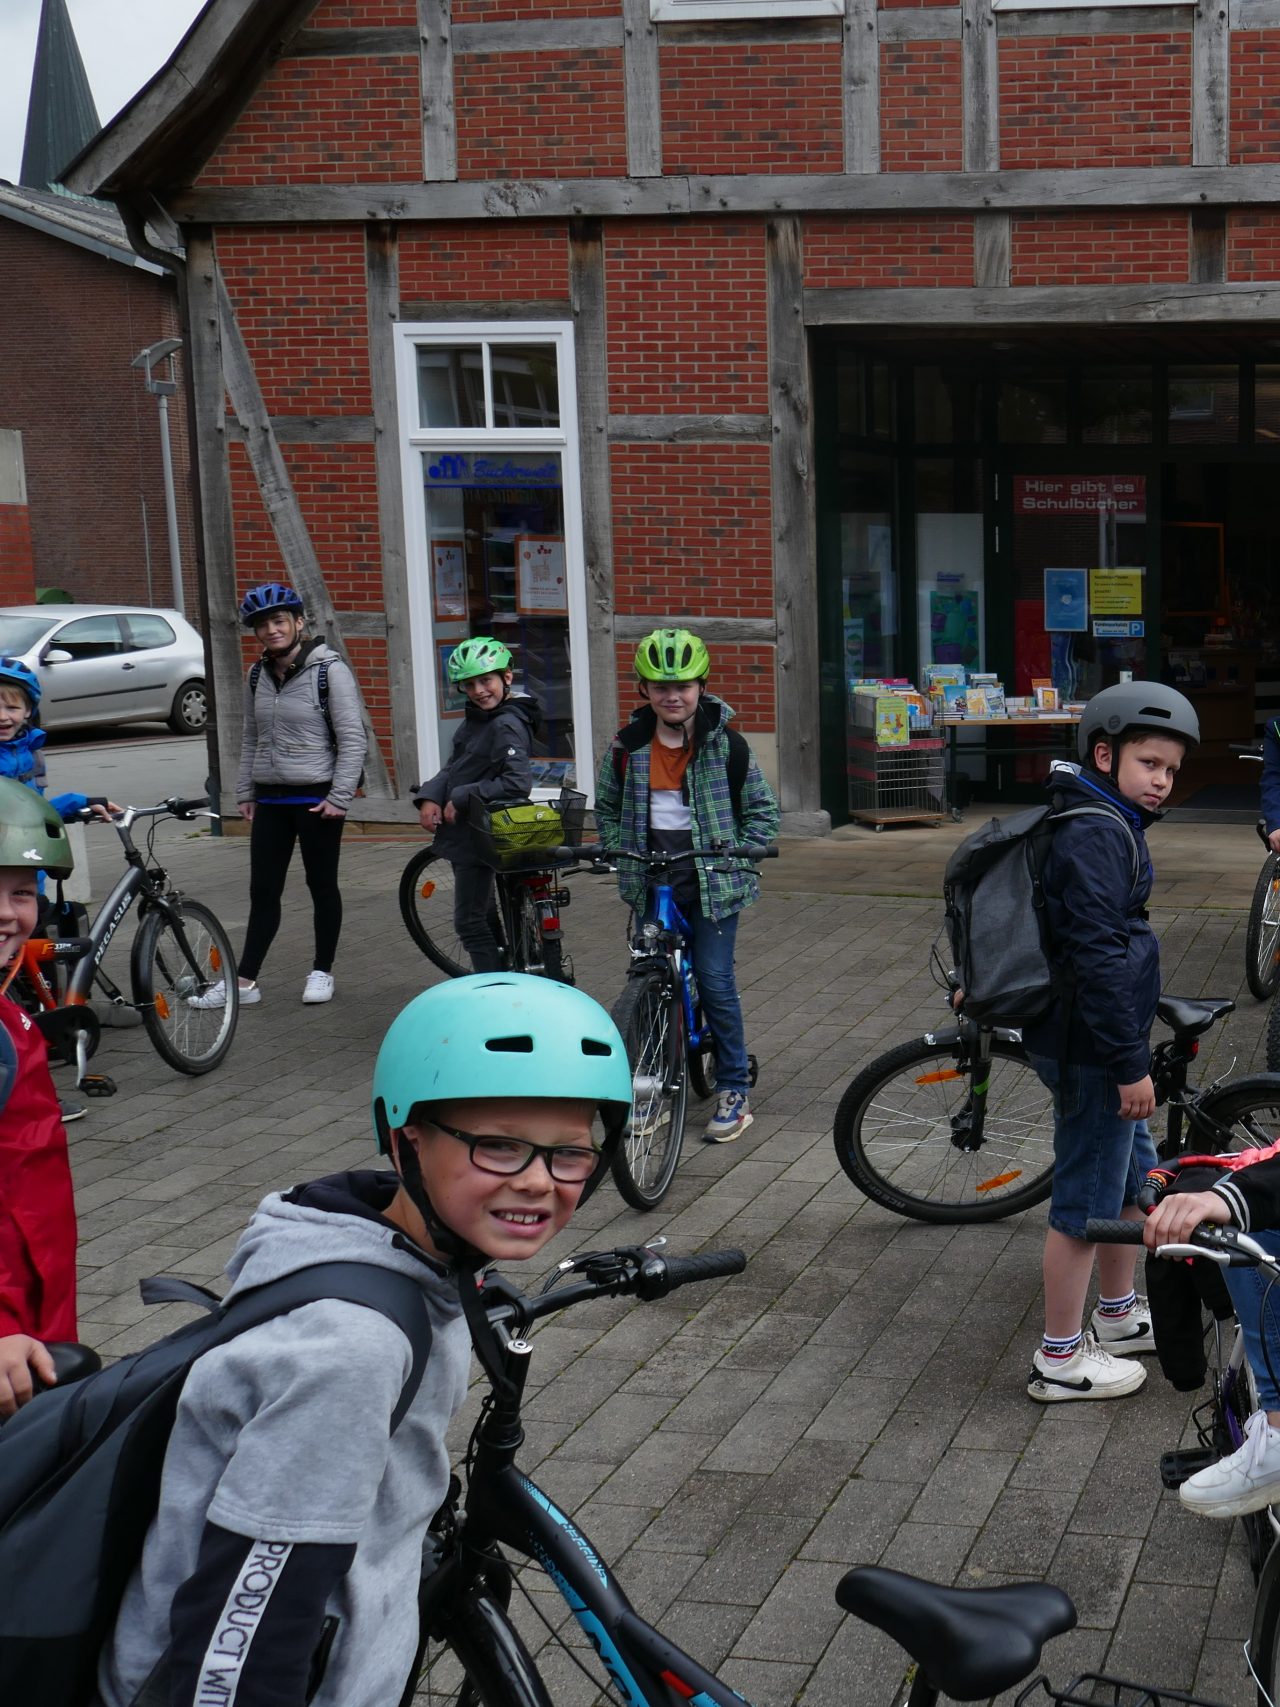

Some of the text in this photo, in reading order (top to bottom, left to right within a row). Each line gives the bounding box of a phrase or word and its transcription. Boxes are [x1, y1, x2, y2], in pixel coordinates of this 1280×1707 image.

[1024, 480, 1135, 495] Hier gibt es
[1022, 497, 1138, 510] Schulbücher
[94, 891, 133, 966] PEGASUS
[1100, 1304, 1124, 1314] NIKE
[1043, 1344, 1068, 1353] NIKE
[213, 1541, 289, 1662] PRODUCT
